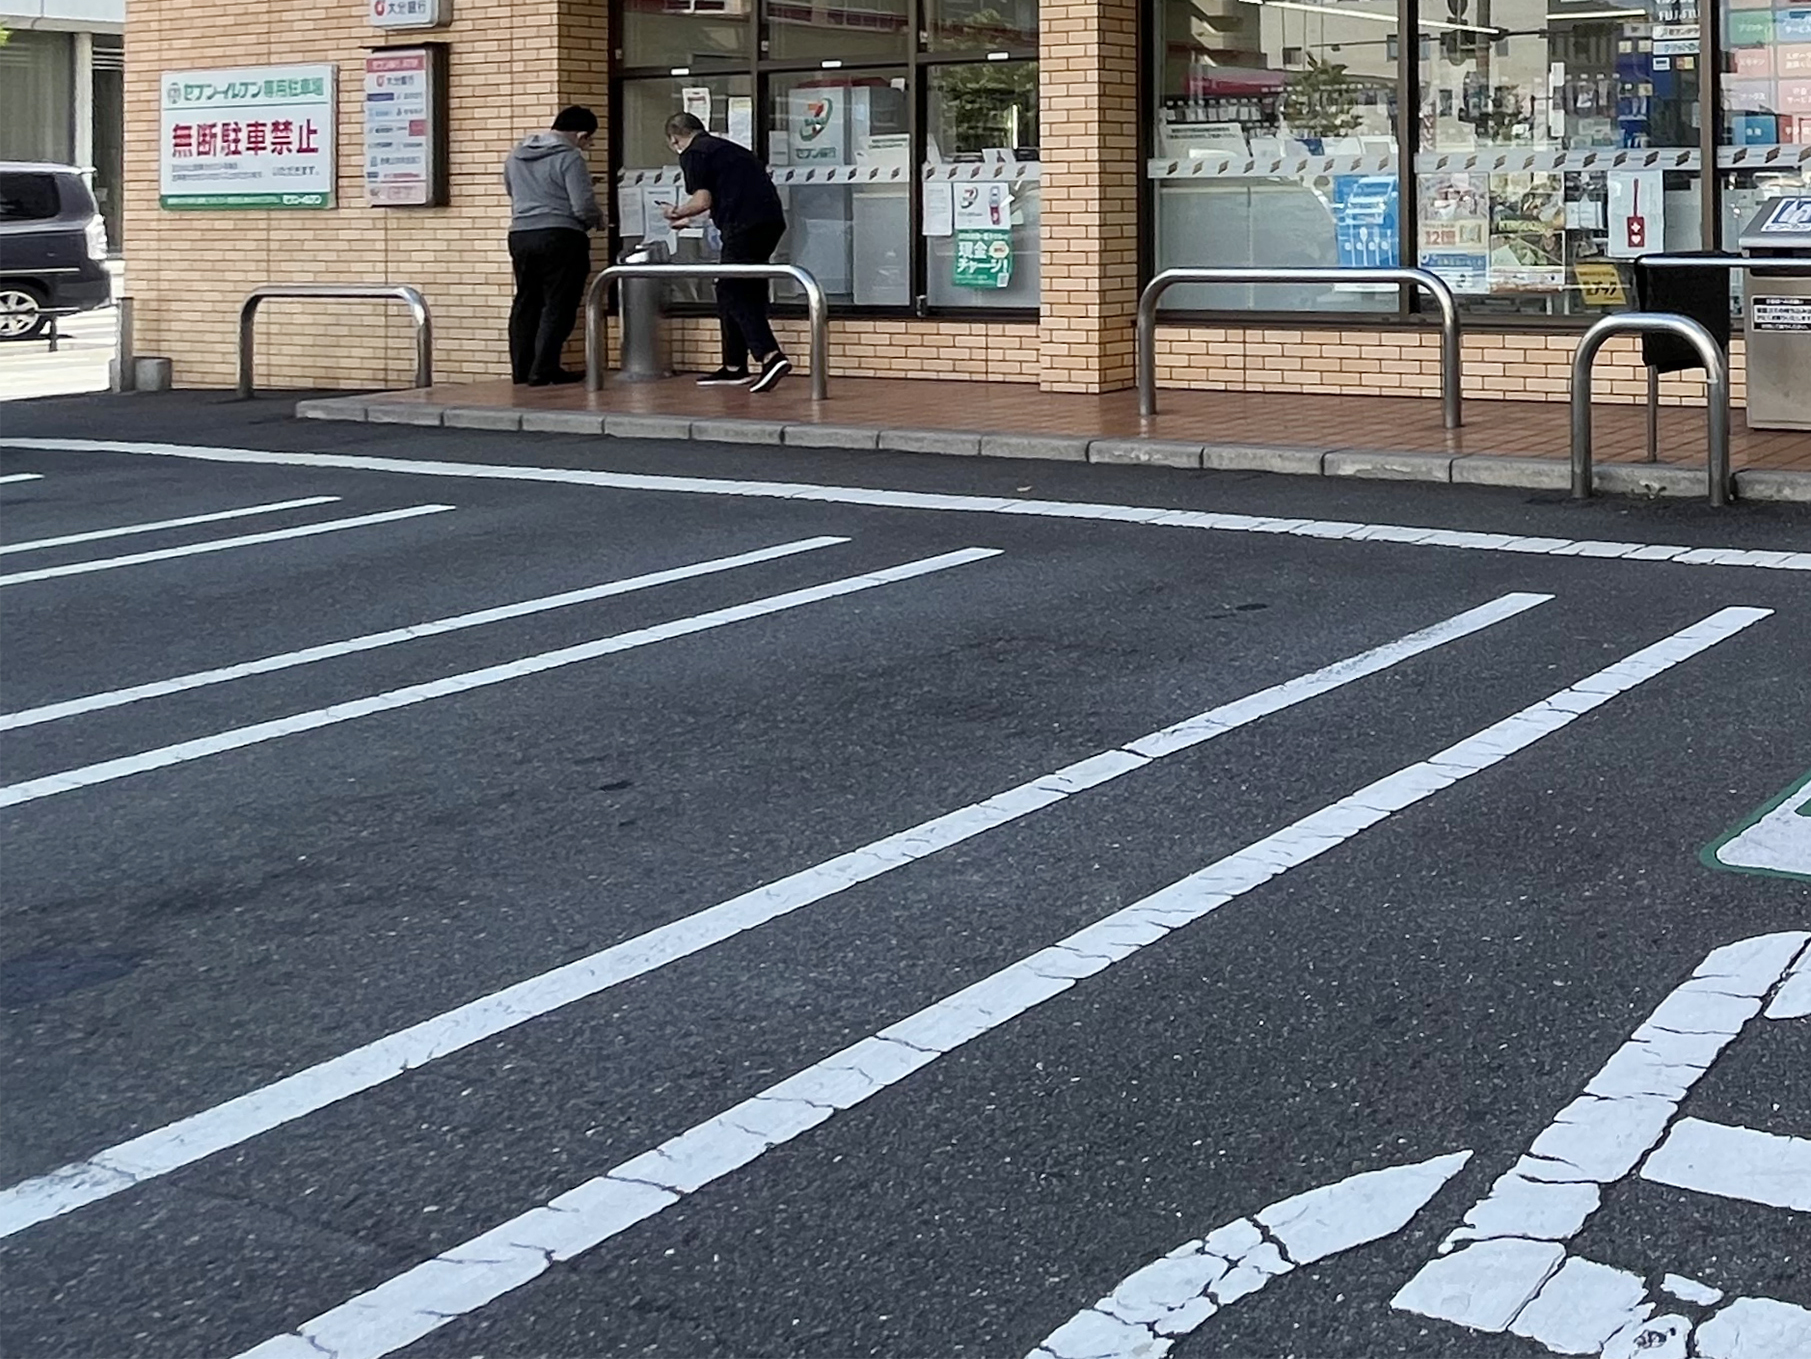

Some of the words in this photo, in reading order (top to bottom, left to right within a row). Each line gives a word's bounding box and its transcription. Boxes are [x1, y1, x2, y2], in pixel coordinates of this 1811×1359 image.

[172, 118, 320, 158] 無断駐車禁止
